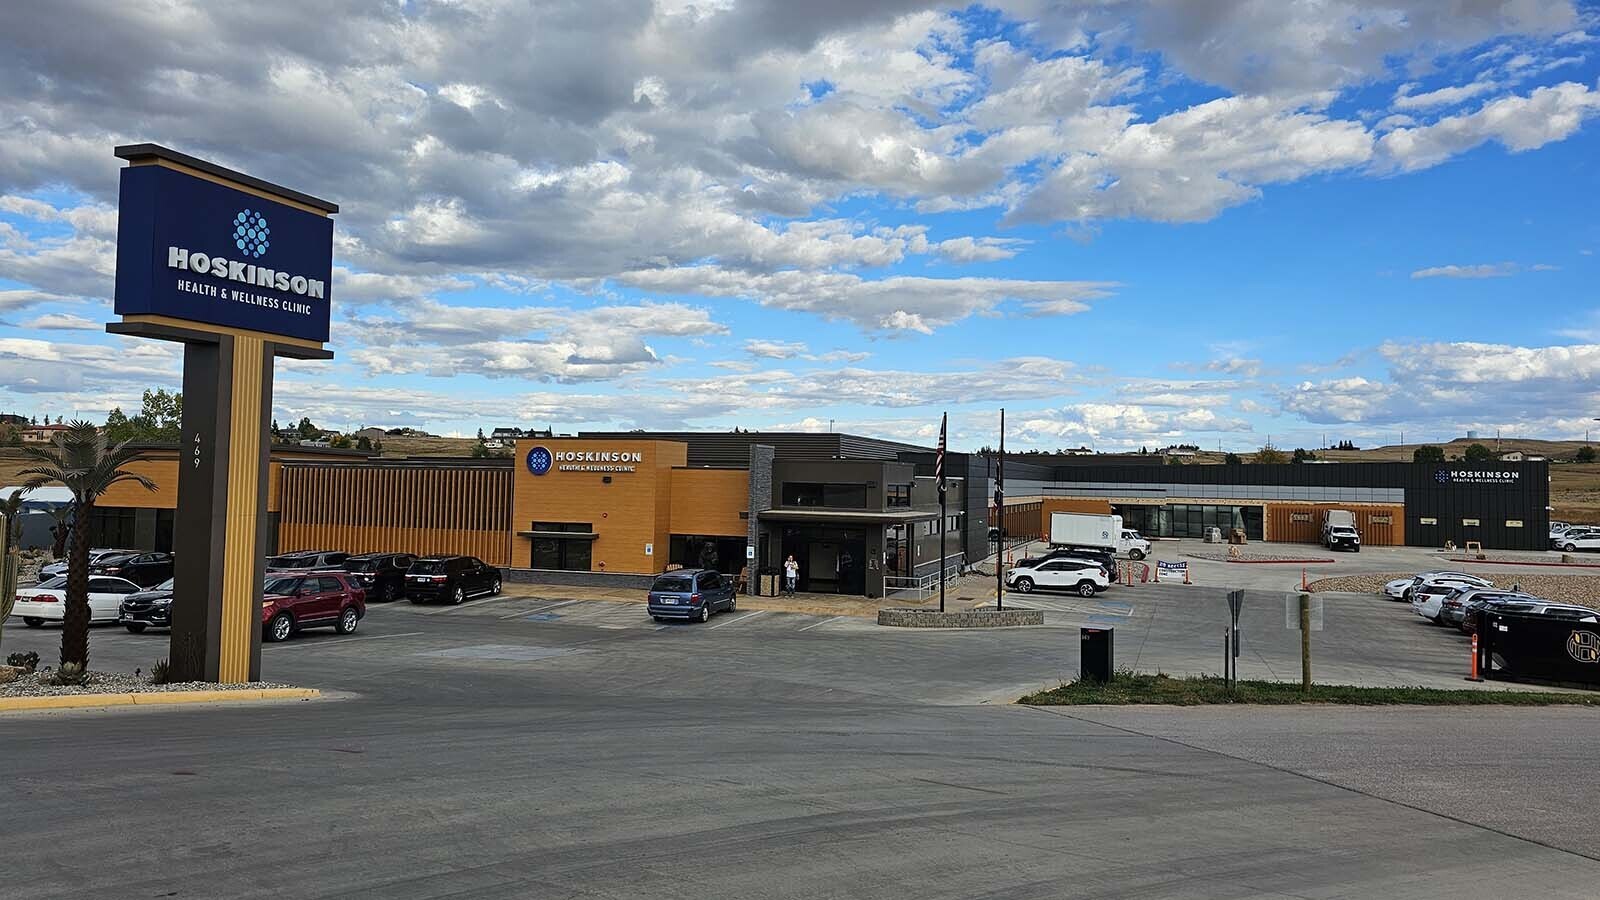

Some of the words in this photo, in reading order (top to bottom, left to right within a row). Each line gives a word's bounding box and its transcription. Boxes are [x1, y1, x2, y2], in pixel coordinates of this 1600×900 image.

[168, 246, 325, 299] HOSKINSON
[177, 279, 217, 297] HEALTH
[221, 288, 227, 299] &
[231, 290, 279, 309] WELLNESS
[282, 300, 311, 315] CLINIC
[555, 451, 642, 462] HOSKINSON
[1450, 470, 1519, 479] HOSKINSON
